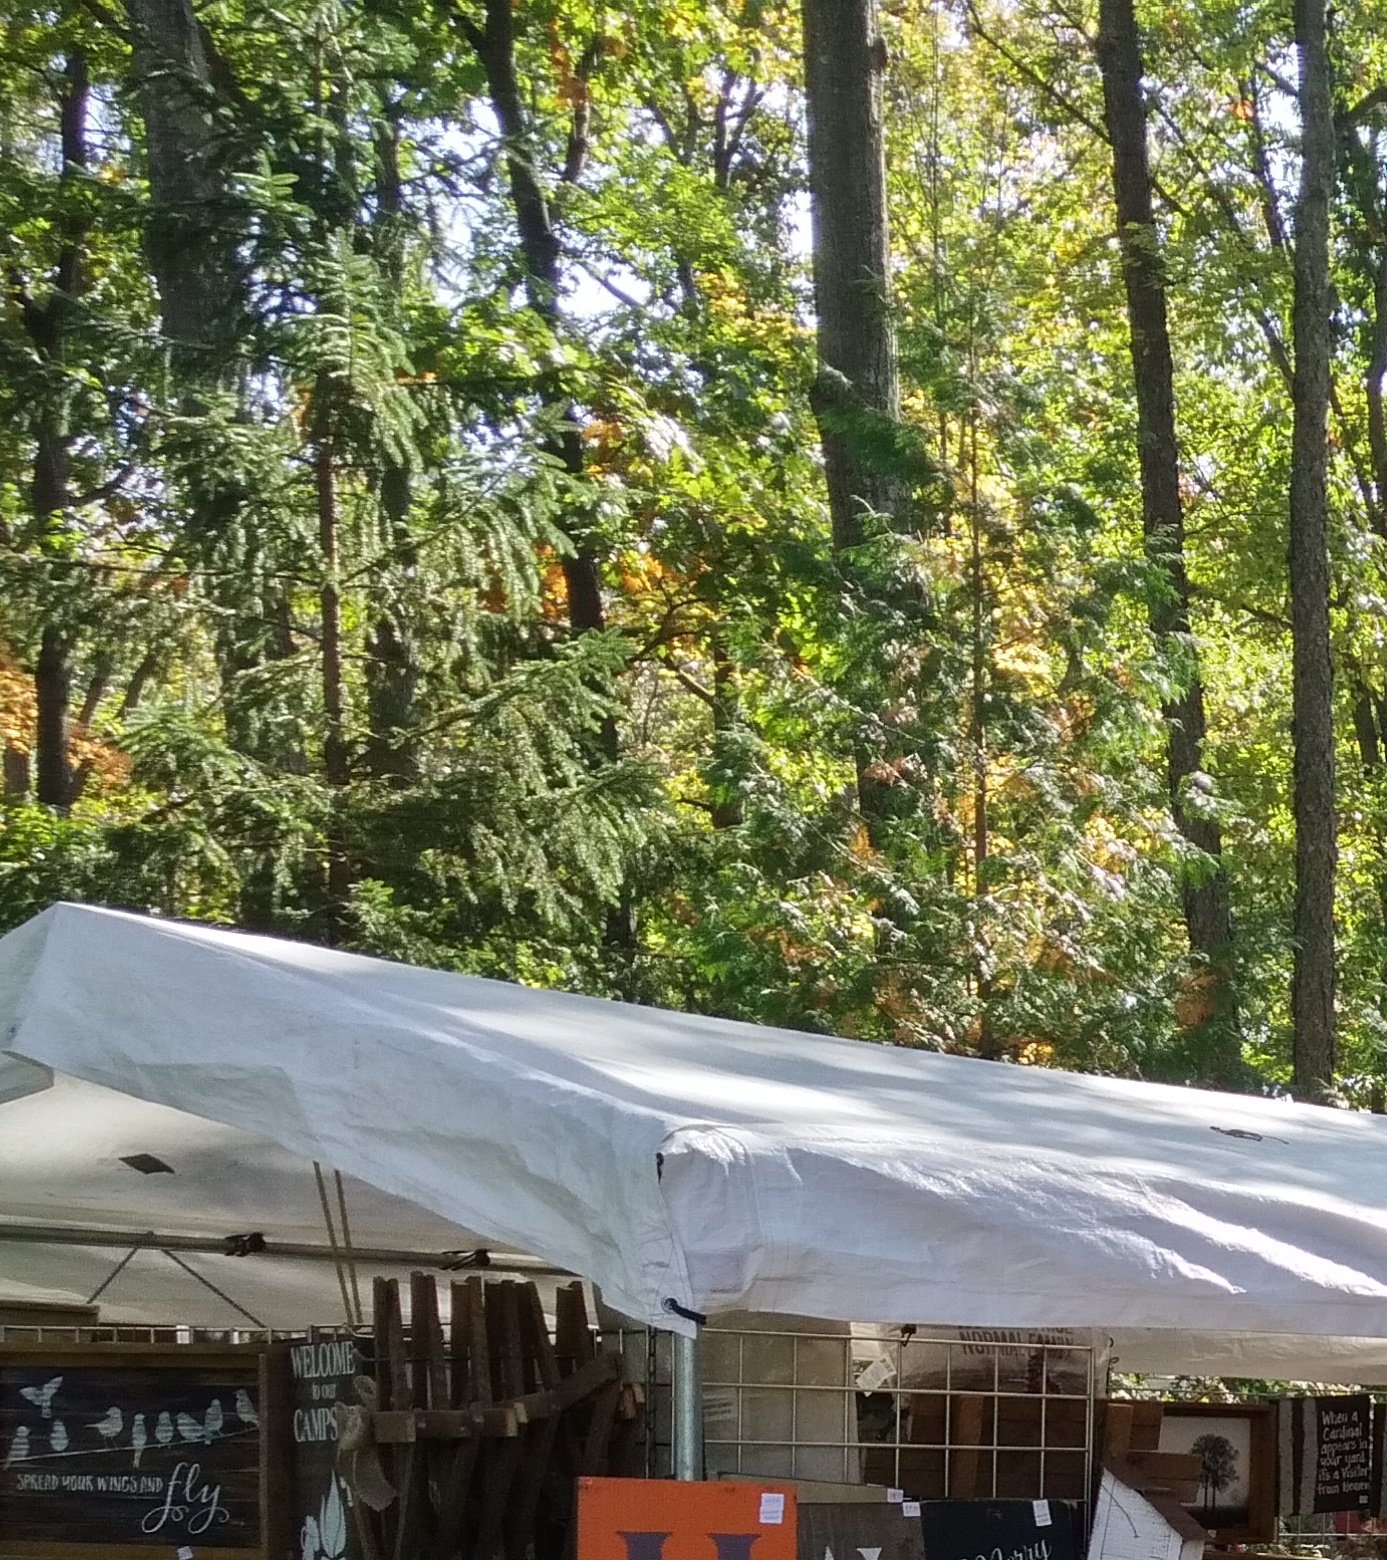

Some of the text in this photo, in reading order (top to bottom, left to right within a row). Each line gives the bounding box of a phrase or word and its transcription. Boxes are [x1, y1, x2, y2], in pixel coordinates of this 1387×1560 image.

[290, 1340, 356, 1379] WELCOME
[1322, 1410, 1359, 1426] When a
[1323, 1422, 1363, 1442] Cardinal
[1320, 1439, 1368, 1457] appears in
[1332, 1469, 1340, 1480] a
[17, 1461, 230, 1535] SPREAD YOUR WINGS AND fly
[1317, 1482, 1340, 1496] from
